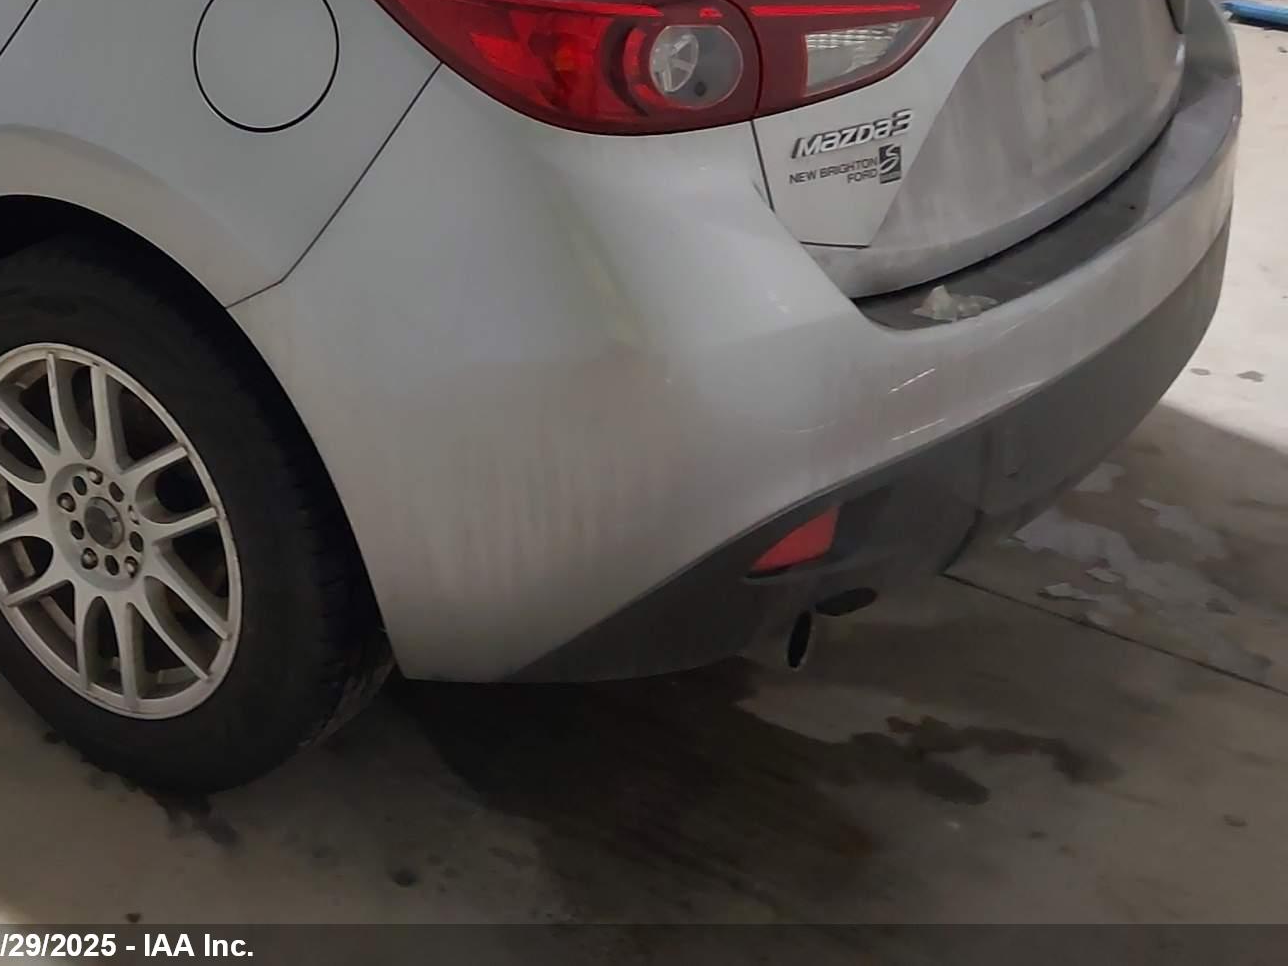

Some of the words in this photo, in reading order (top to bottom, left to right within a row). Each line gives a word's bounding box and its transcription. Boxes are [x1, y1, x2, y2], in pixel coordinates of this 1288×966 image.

[789, 169, 817, 184] NEW
[819, 157, 878, 178] BRIGHTON
[847, 168, 878, 183] FORD
